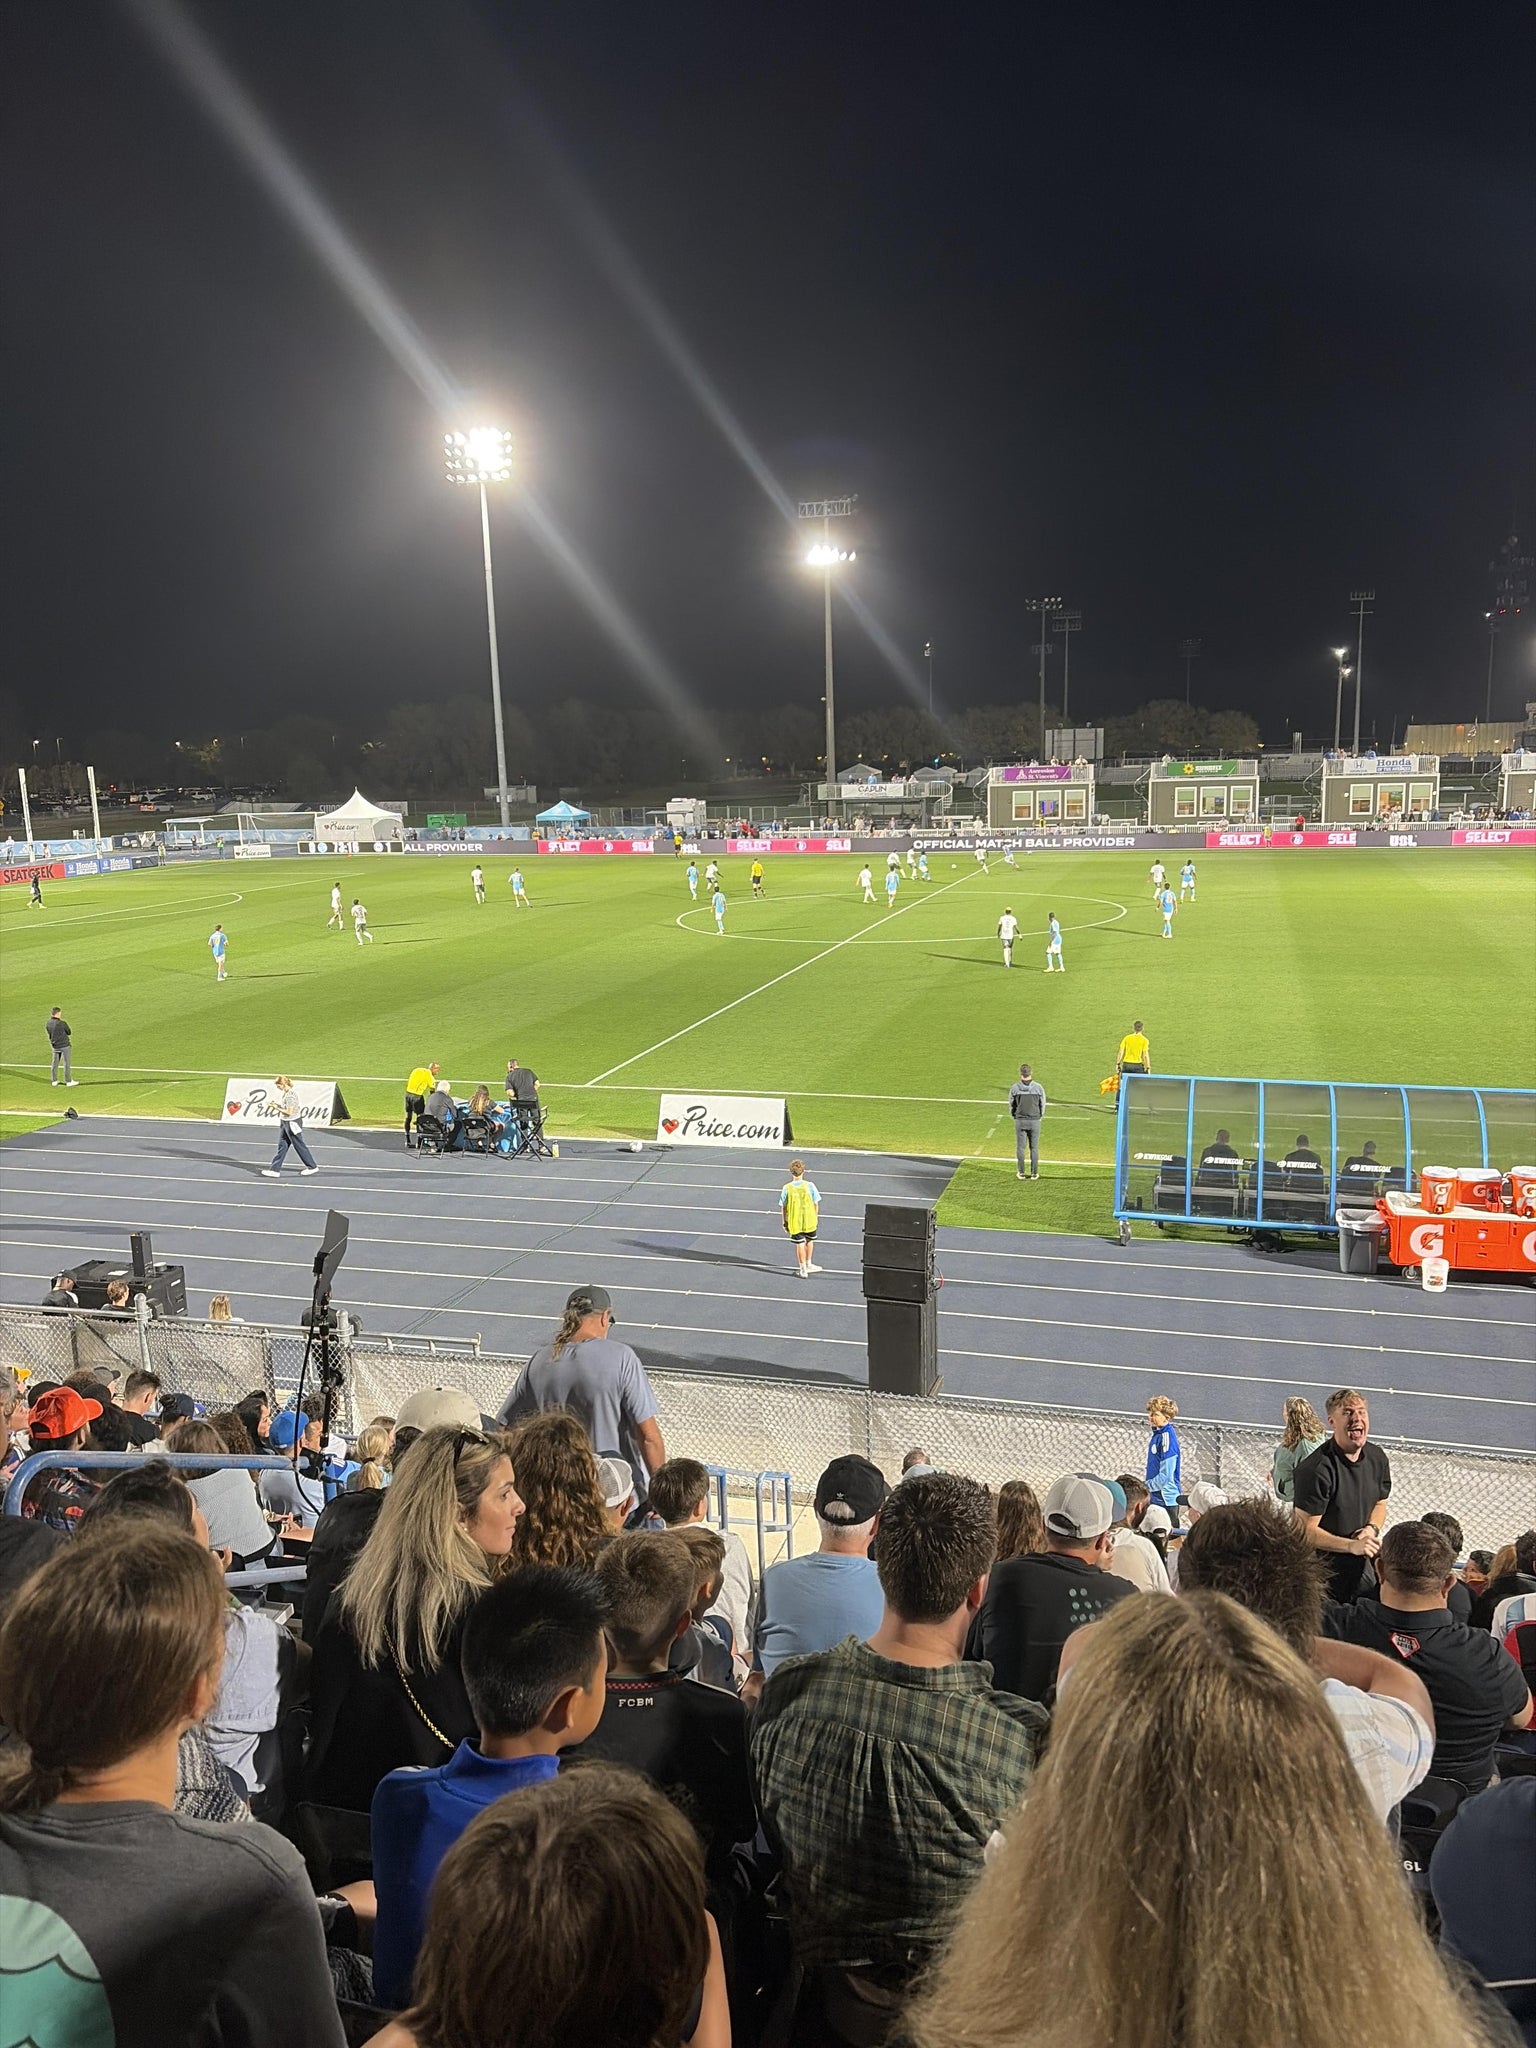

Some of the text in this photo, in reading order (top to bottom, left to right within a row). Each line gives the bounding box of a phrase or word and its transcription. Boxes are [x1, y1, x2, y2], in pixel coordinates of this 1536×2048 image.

[1219, 834, 1261, 845] SELECT
[1465, 831, 1511, 843] SELECT
[426, 843, 483, 851] PROVIDER
[736, 841, 771, 850] SELECT
[913, 837, 1135, 849] OFFICIAL MATCH BALL PROVIDER
[682, 1105, 780, 1139] Price.com
[1410, 1223, 1444, 1258] G
[618, 1697, 654, 1707] FCBM
